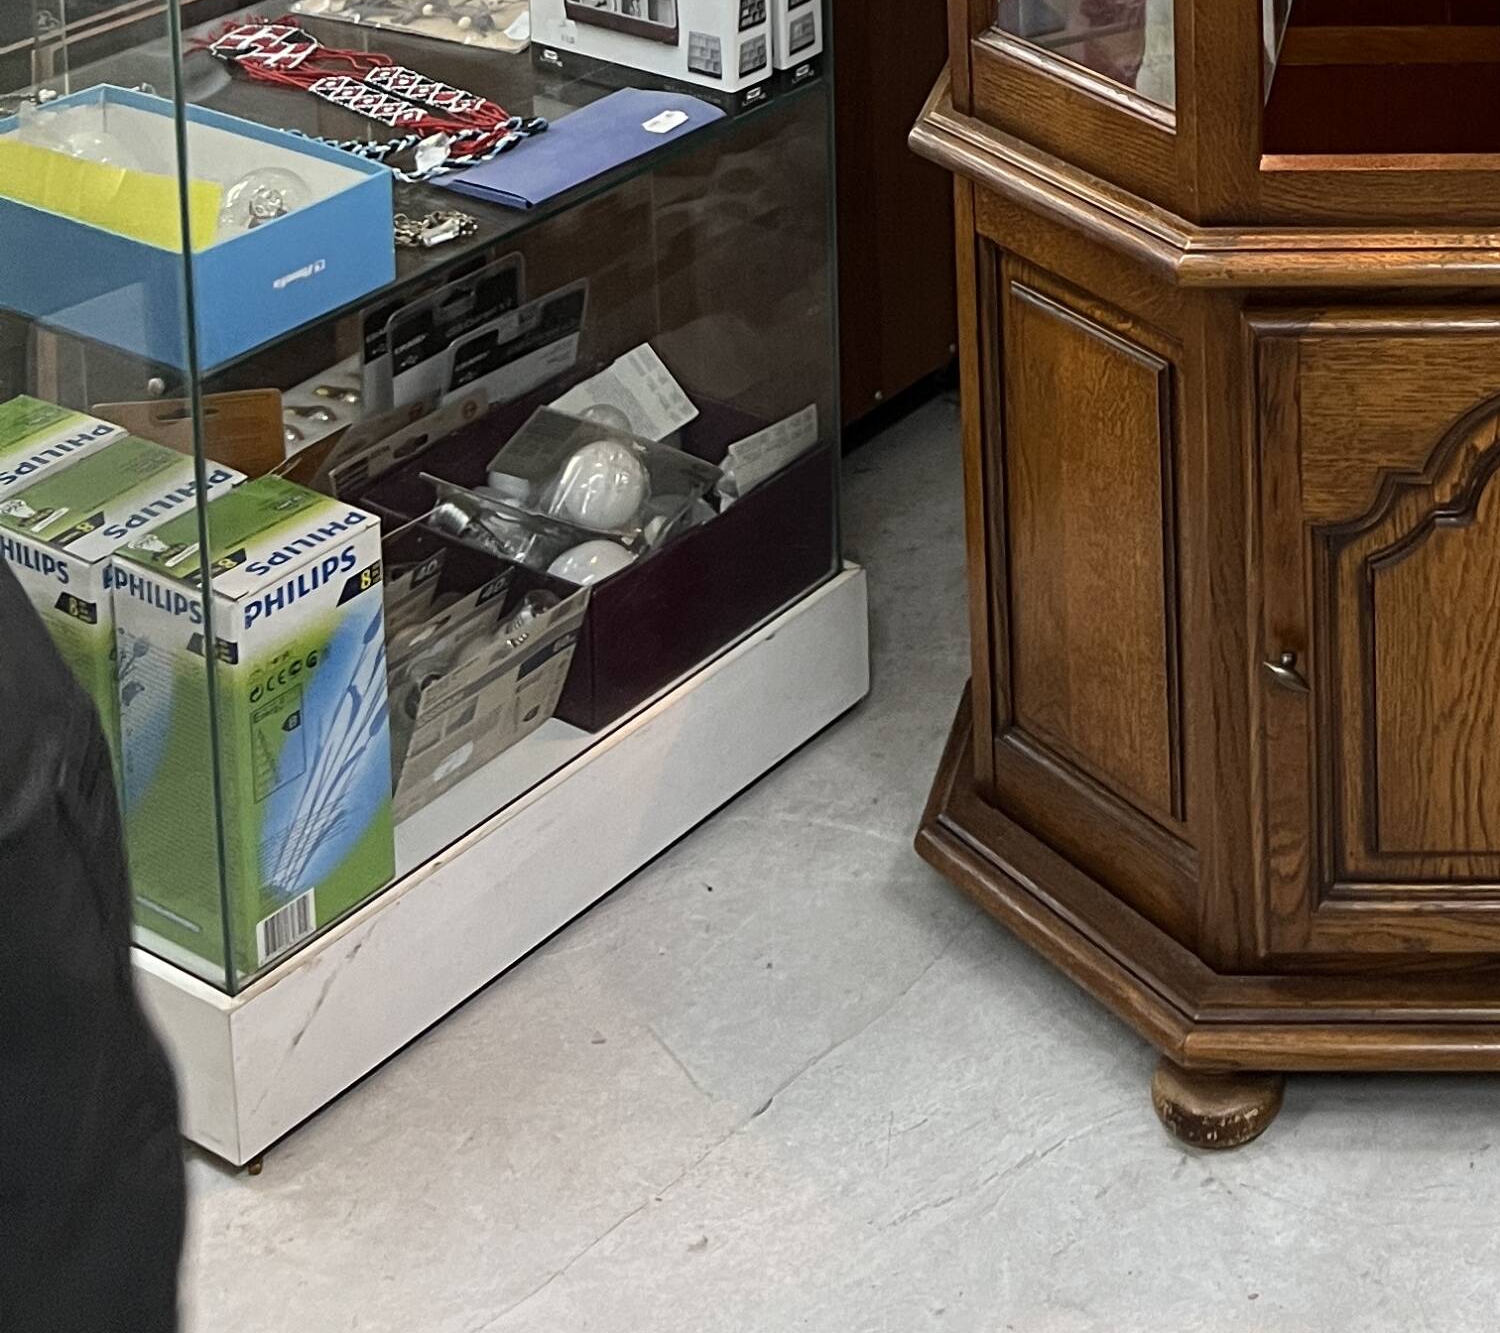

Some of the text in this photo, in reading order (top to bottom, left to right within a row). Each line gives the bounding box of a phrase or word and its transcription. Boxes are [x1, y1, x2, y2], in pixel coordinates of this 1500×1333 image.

[0, 424, 116, 485] PHILIPS
[245, 511, 368, 577] PHILIPS
[113, 565, 206, 625] PHILIPS
[243, 545, 357, 631] PHILIPS
[360, 568, 372, 591] 8
